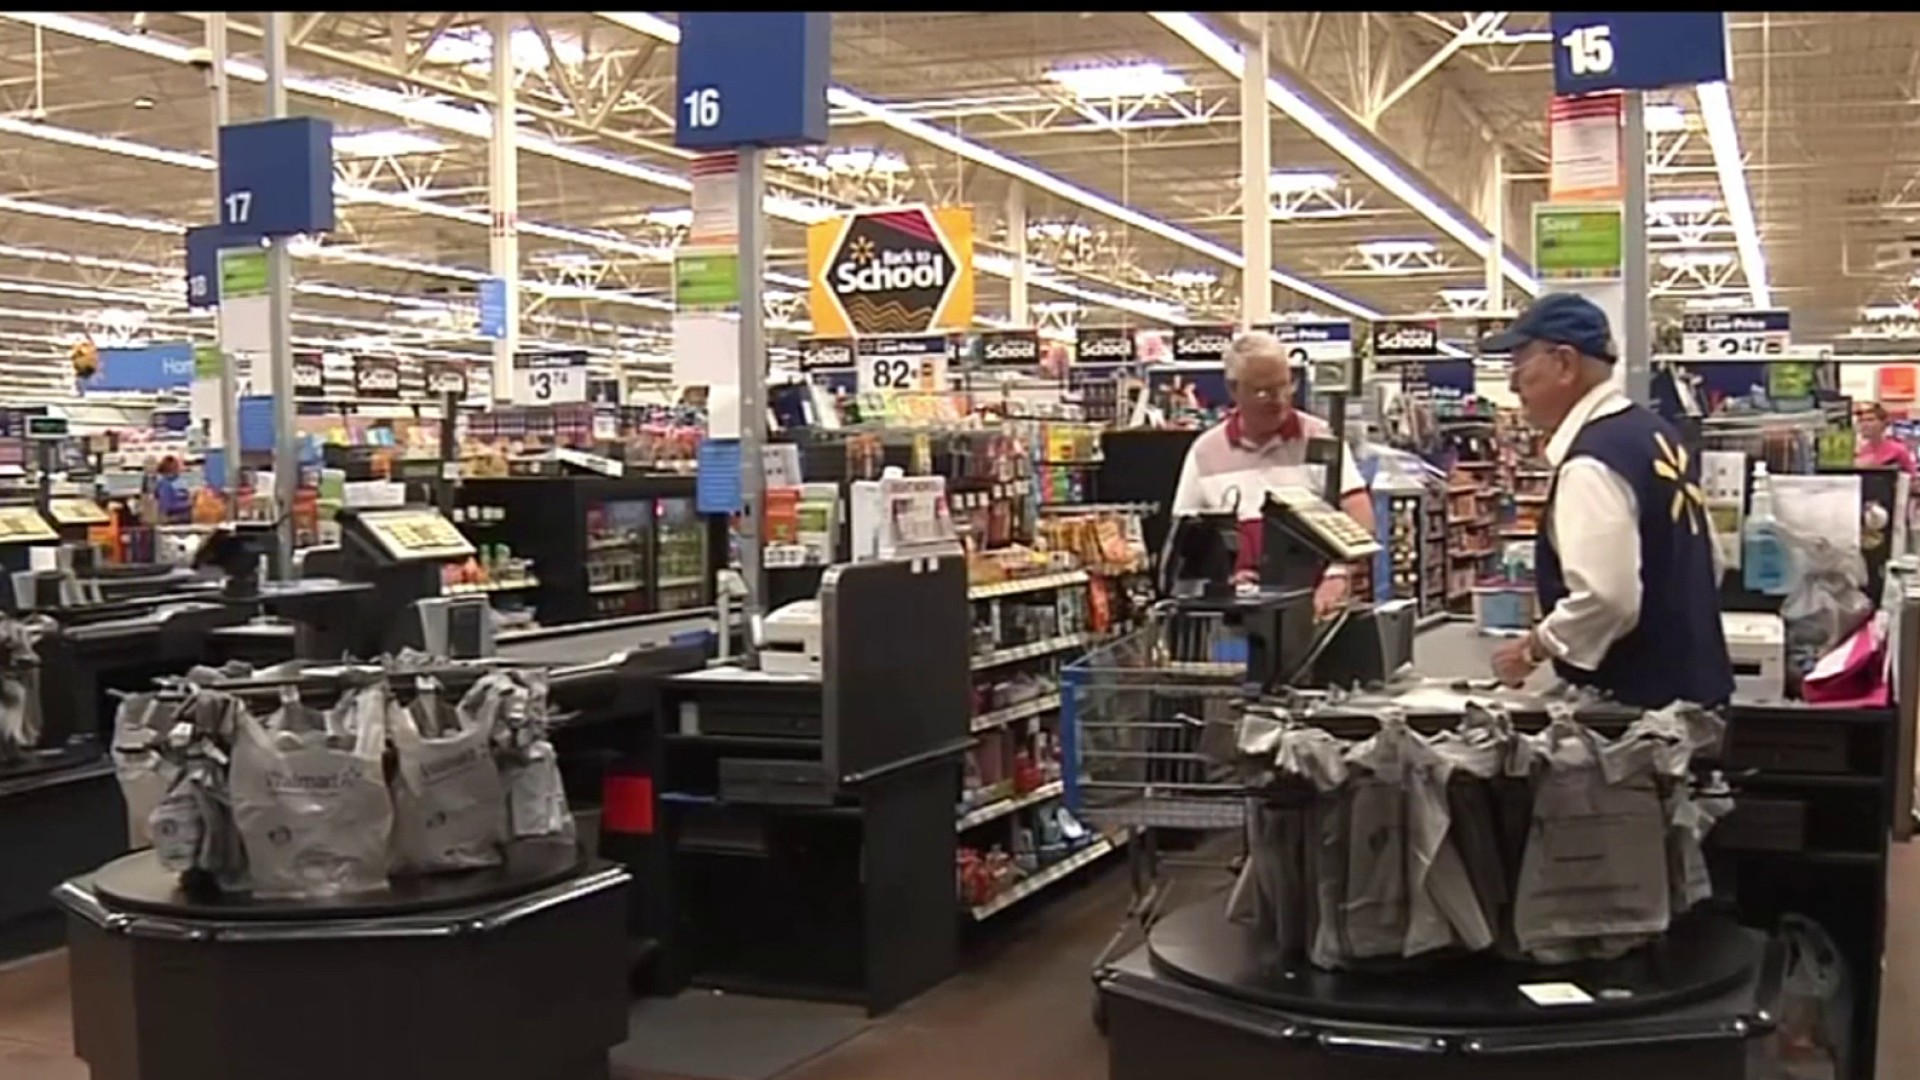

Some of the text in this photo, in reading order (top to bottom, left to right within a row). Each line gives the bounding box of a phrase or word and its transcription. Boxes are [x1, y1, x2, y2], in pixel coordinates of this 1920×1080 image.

[1561, 25, 1614, 75] 15
[683, 88, 720, 127] 16
[225, 191, 252, 223] 17
[882, 250, 914, 265] Back
[837, 254, 944, 294] School
[1080, 340, 1131, 356] School
[1178, 336, 1231, 354] School
[1378, 331, 1432, 349] School
[985, 342, 1034, 358] School
